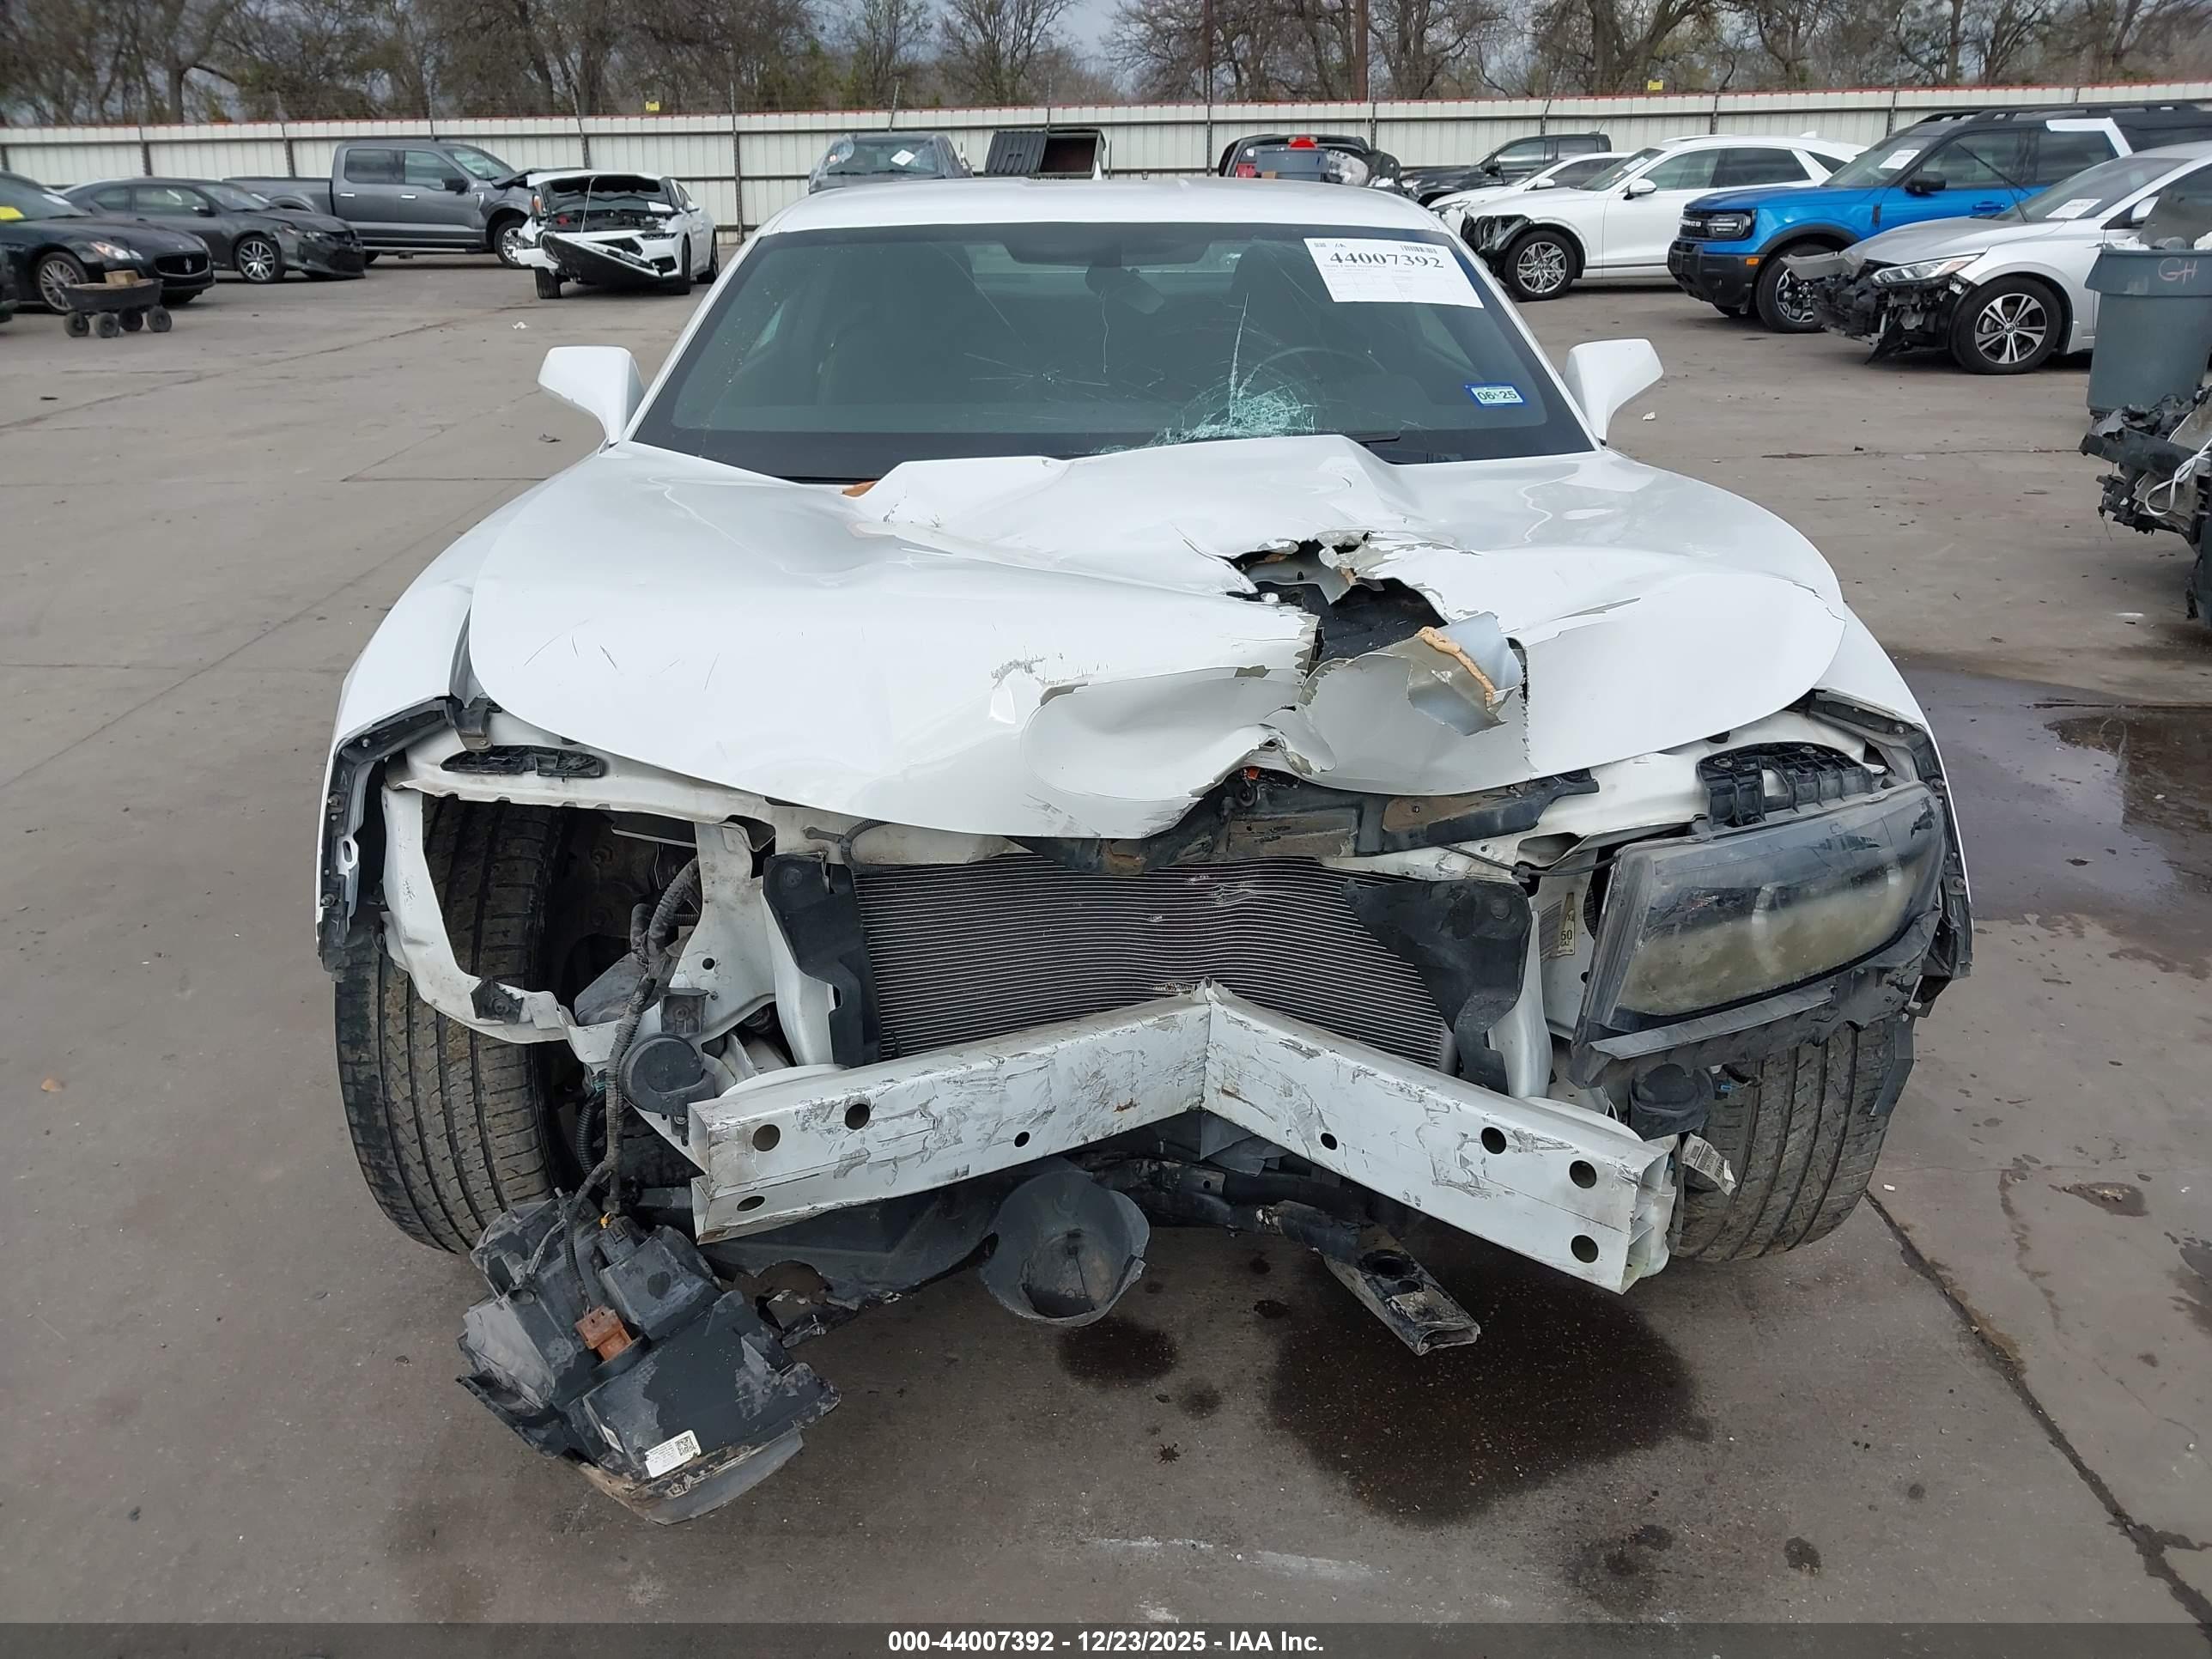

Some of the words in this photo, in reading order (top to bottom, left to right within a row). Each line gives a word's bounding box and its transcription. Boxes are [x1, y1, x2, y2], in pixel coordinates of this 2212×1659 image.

[1329, 252, 1444, 269] 44007392
[1477, 391, 1495, 400] 06
[1499, 390, 1517, 399] 25
